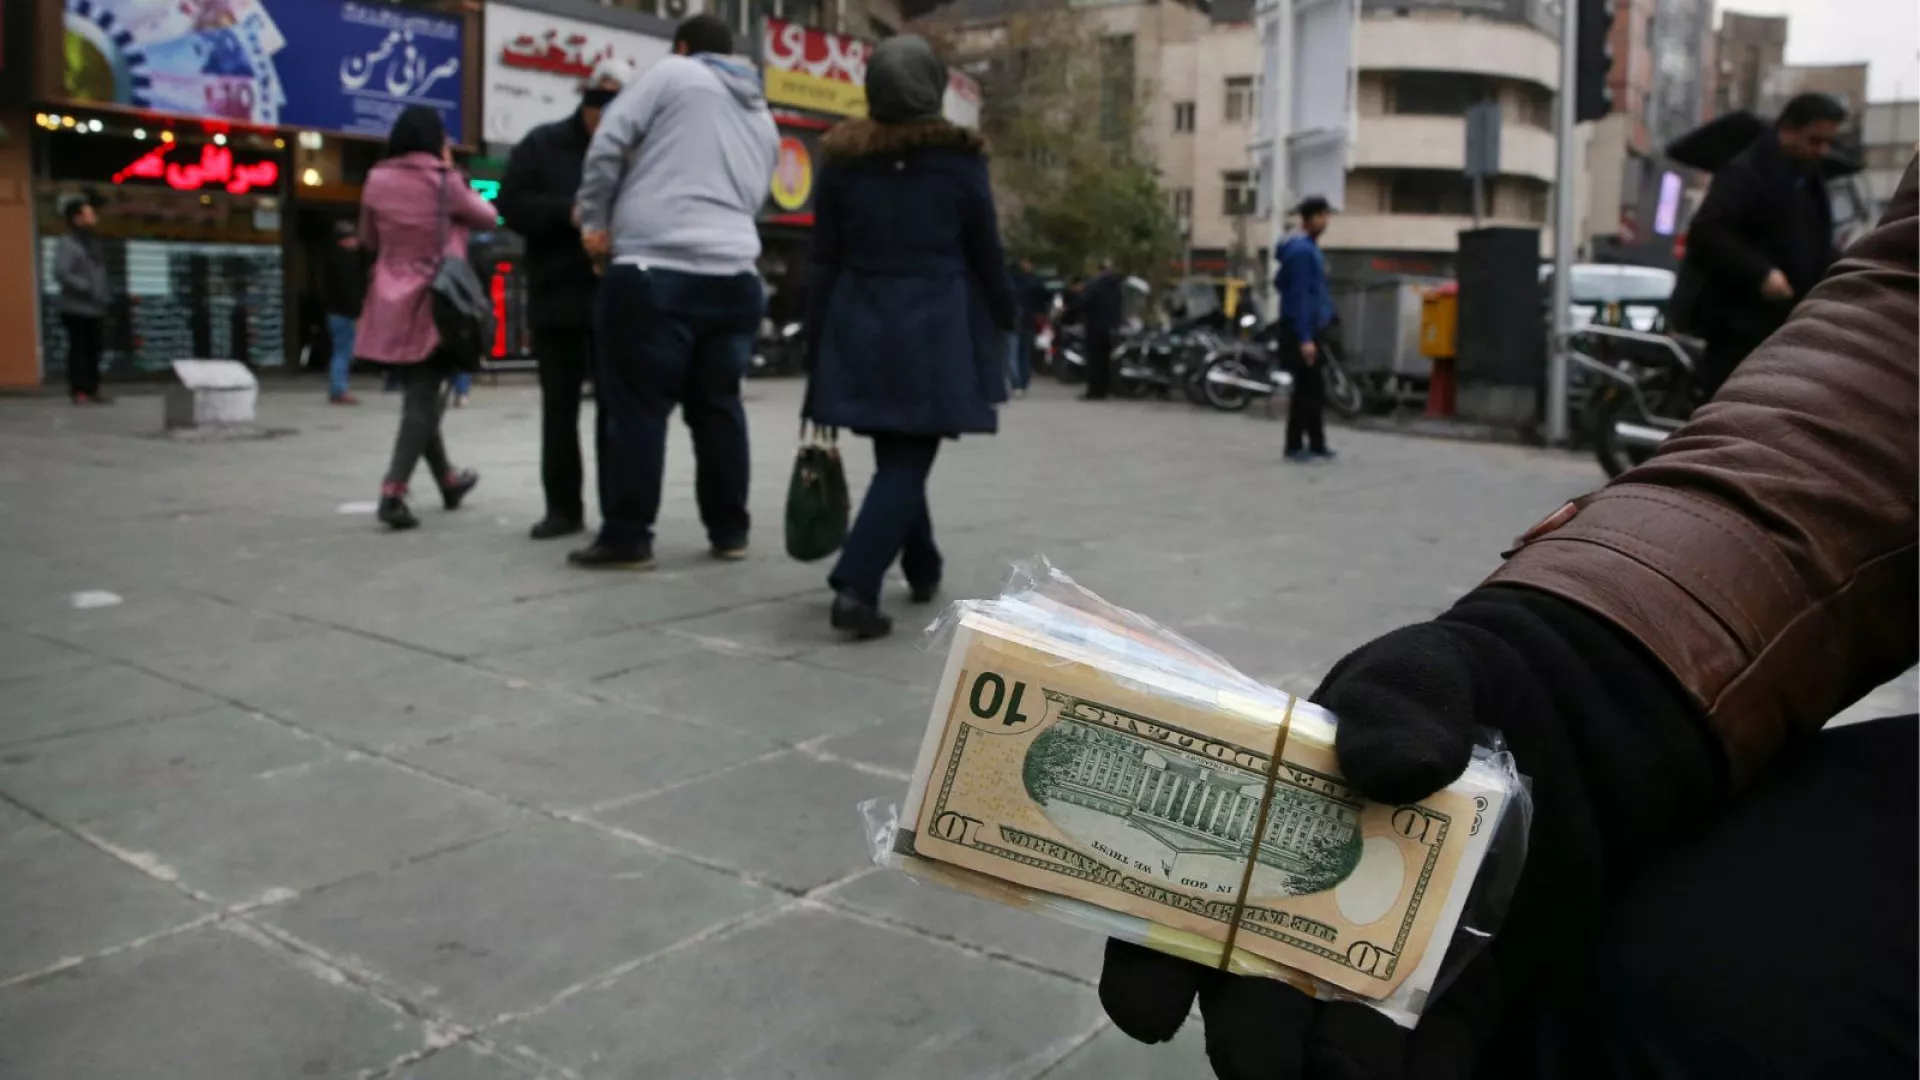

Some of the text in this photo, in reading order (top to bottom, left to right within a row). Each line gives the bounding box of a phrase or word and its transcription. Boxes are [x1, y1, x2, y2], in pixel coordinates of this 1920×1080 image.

[340, 29, 459, 98] صرافی محسن
[969, 671, 1028, 727] 10
[1073, 701, 1268, 773] DOLLARS
[935, 811, 984, 844] 10
[1391, 806, 1447, 846] 10
[1000, 826, 1338, 944] THE UNITED STATES OF AMERICA
[1091, 840, 1233, 893] IN GOD WE TRUST
[1347, 941, 1397, 976] 10
